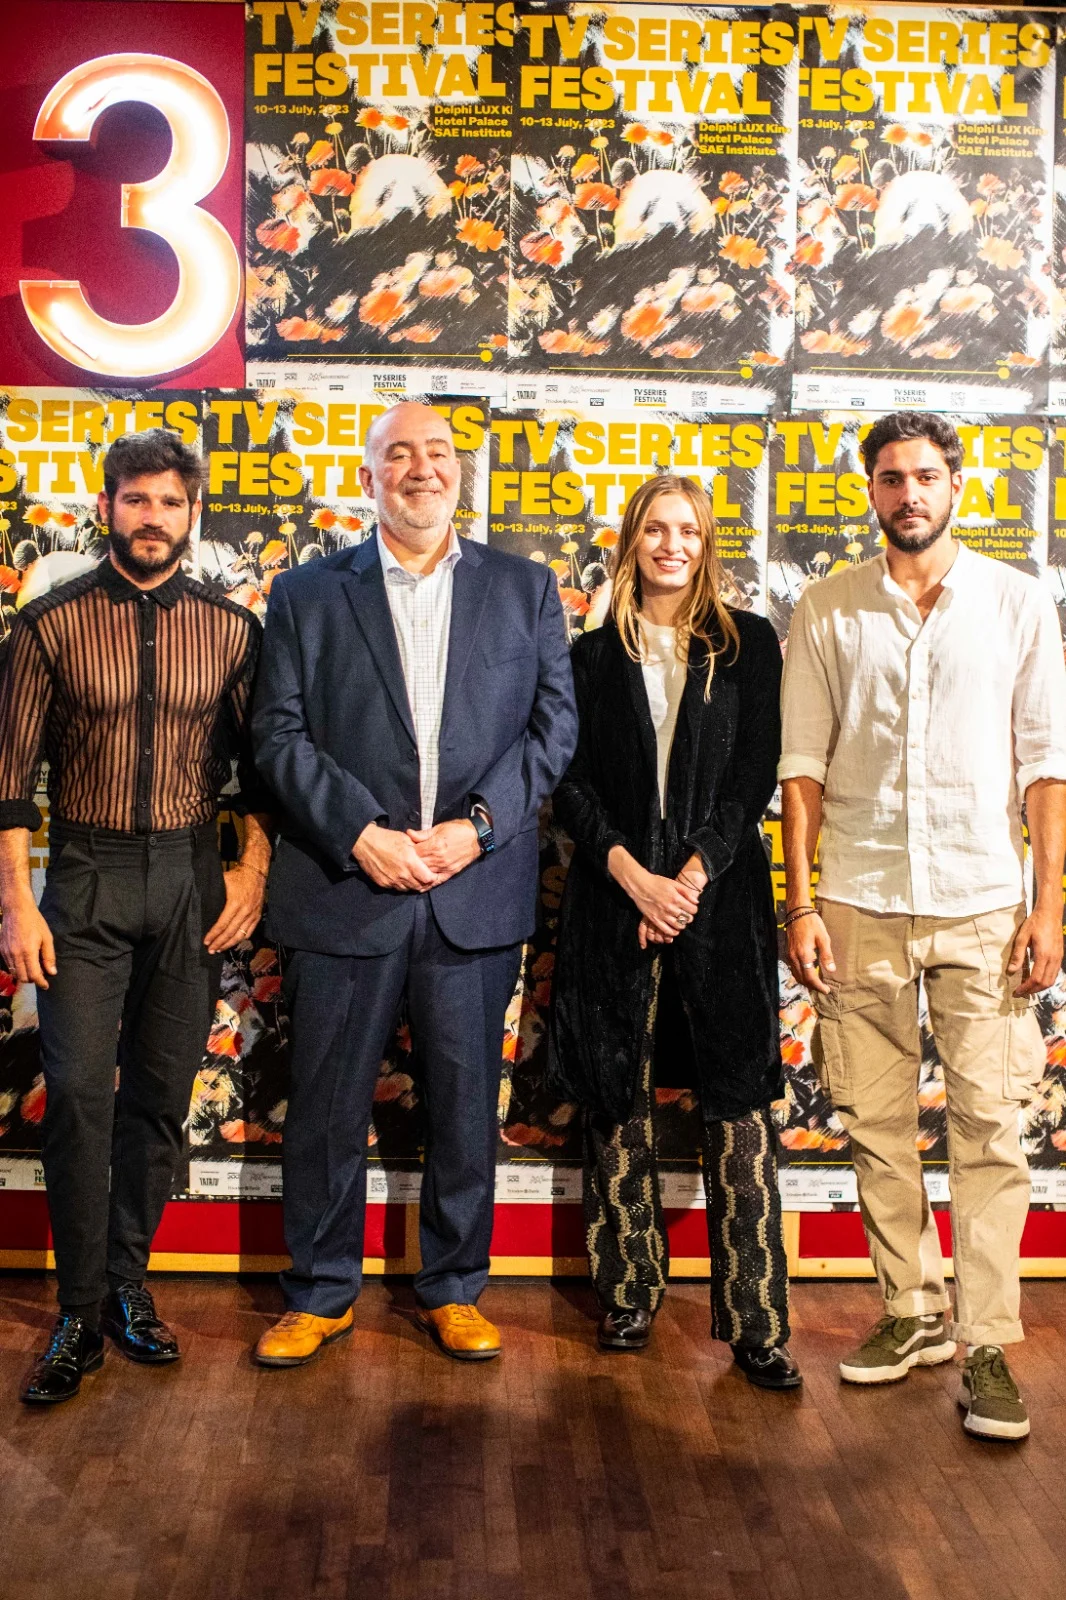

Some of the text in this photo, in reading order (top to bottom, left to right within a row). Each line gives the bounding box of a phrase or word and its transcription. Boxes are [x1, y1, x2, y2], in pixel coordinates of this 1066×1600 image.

[254, 2, 514, 47] TV SERIES
[521, 15, 795, 66] TV SERIES
[863, 18, 1050, 68] SERIES
[254, 53, 506, 97] FESTIVAL
[520, 65, 771, 115] FESTIVAL
[288, 105, 316, 115] July,
[319, 105, 349, 114] 2023
[434, 105, 472, 116] Delphi
[475, 105, 499, 114] LUX
[435, 117, 508, 126] Hotel Palace
[555, 118, 583, 129] July,
[584, 119, 616, 129] 2023
[815, 119, 843, 131] July,
[434, 128, 512, 138] SAE Institute
[699, 123, 738, 134] Delphi
[739, 124, 764, 133] LUX
[958, 124, 995, 136] Delphi
[997, 125, 1022, 134] LUX
[699, 134, 772, 144] Hotel Palace
[958, 135, 1029, 146] Hotel Palace
[699, 145, 777, 156] SAE Institute
[958, 146, 1033, 158] SAE Institute
[19, 53, 241, 377] 3
[893, 388, 902, 396] TV
[6, 398, 198, 444] SERIES
[210, 400, 278, 445] TV
[491, 420, 764, 468] TV SERIES
[776, 421, 844, 466] TV
[242, 504, 270, 515] July,
[273, 504, 304, 514] 2023
[525, 524, 553, 535] July,
[810, 524, 838, 536] July,
[952, 527, 988, 538] Delphi
[990, 528, 1015, 537] LUX
[985, 539, 1023, 548] Palace
